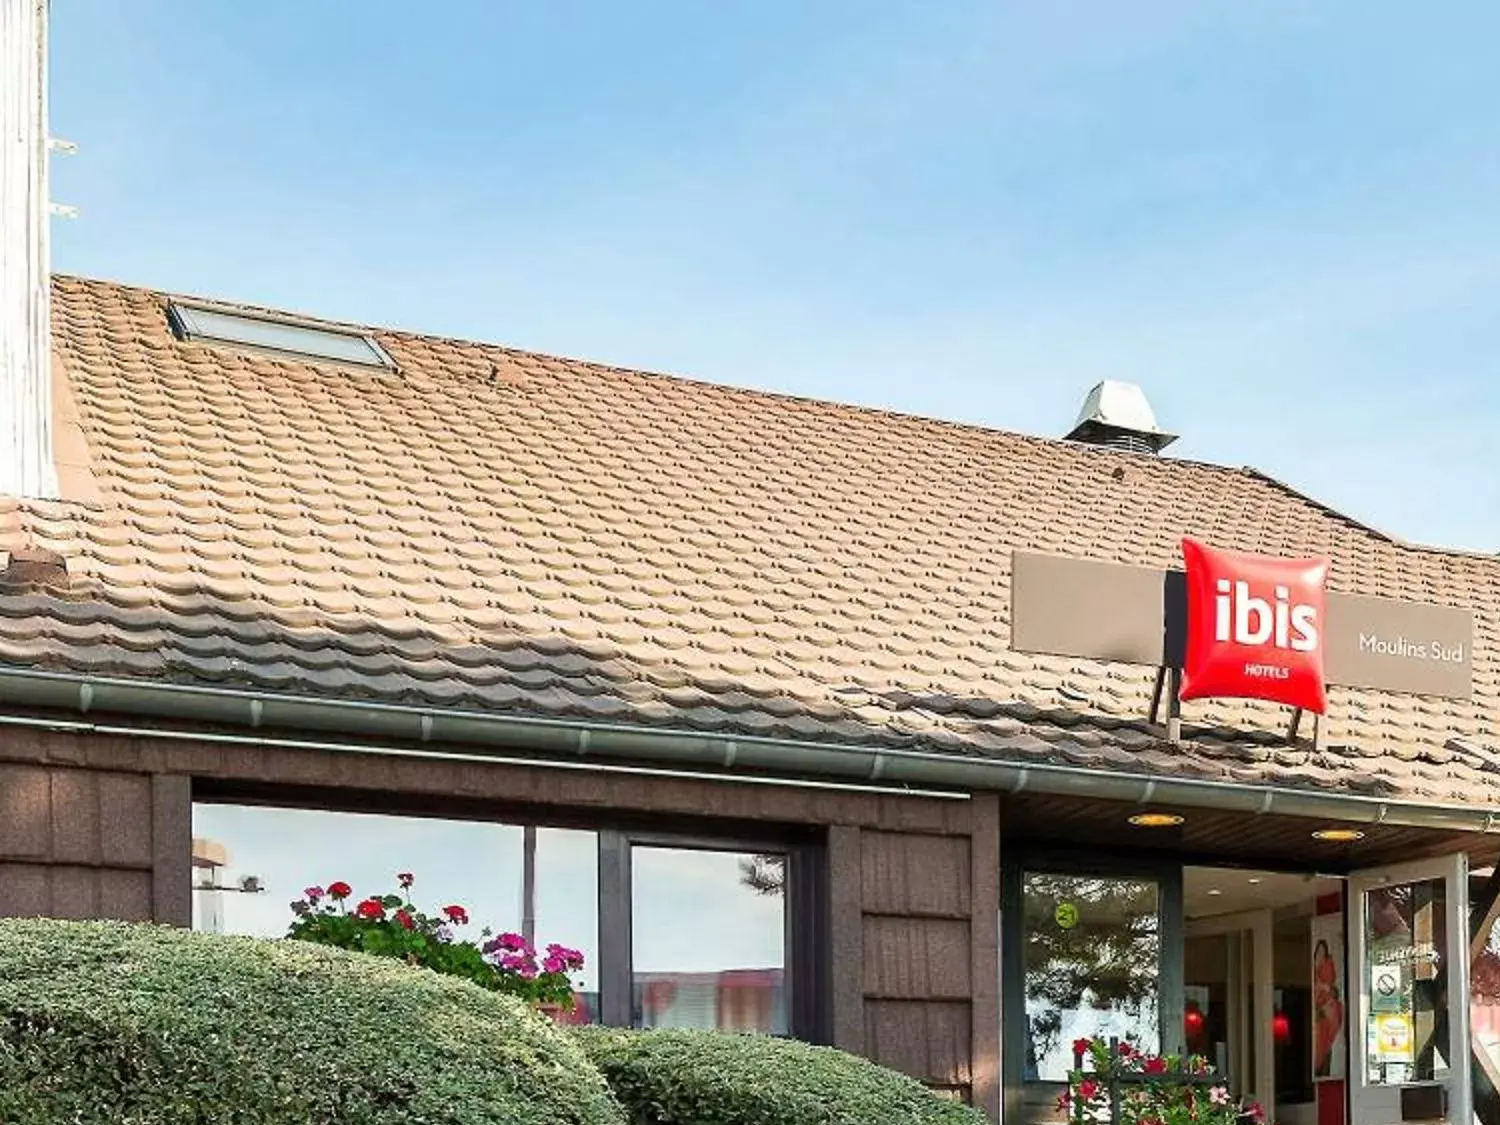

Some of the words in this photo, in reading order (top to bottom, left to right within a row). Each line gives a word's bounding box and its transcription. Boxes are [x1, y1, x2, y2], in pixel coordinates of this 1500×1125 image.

[1215, 579, 1318, 652] ibis
[1359, 632, 1427, 659] Moulins
[1431, 640, 1463, 663] Sud
[1244, 663, 1290, 679] HOTELS
